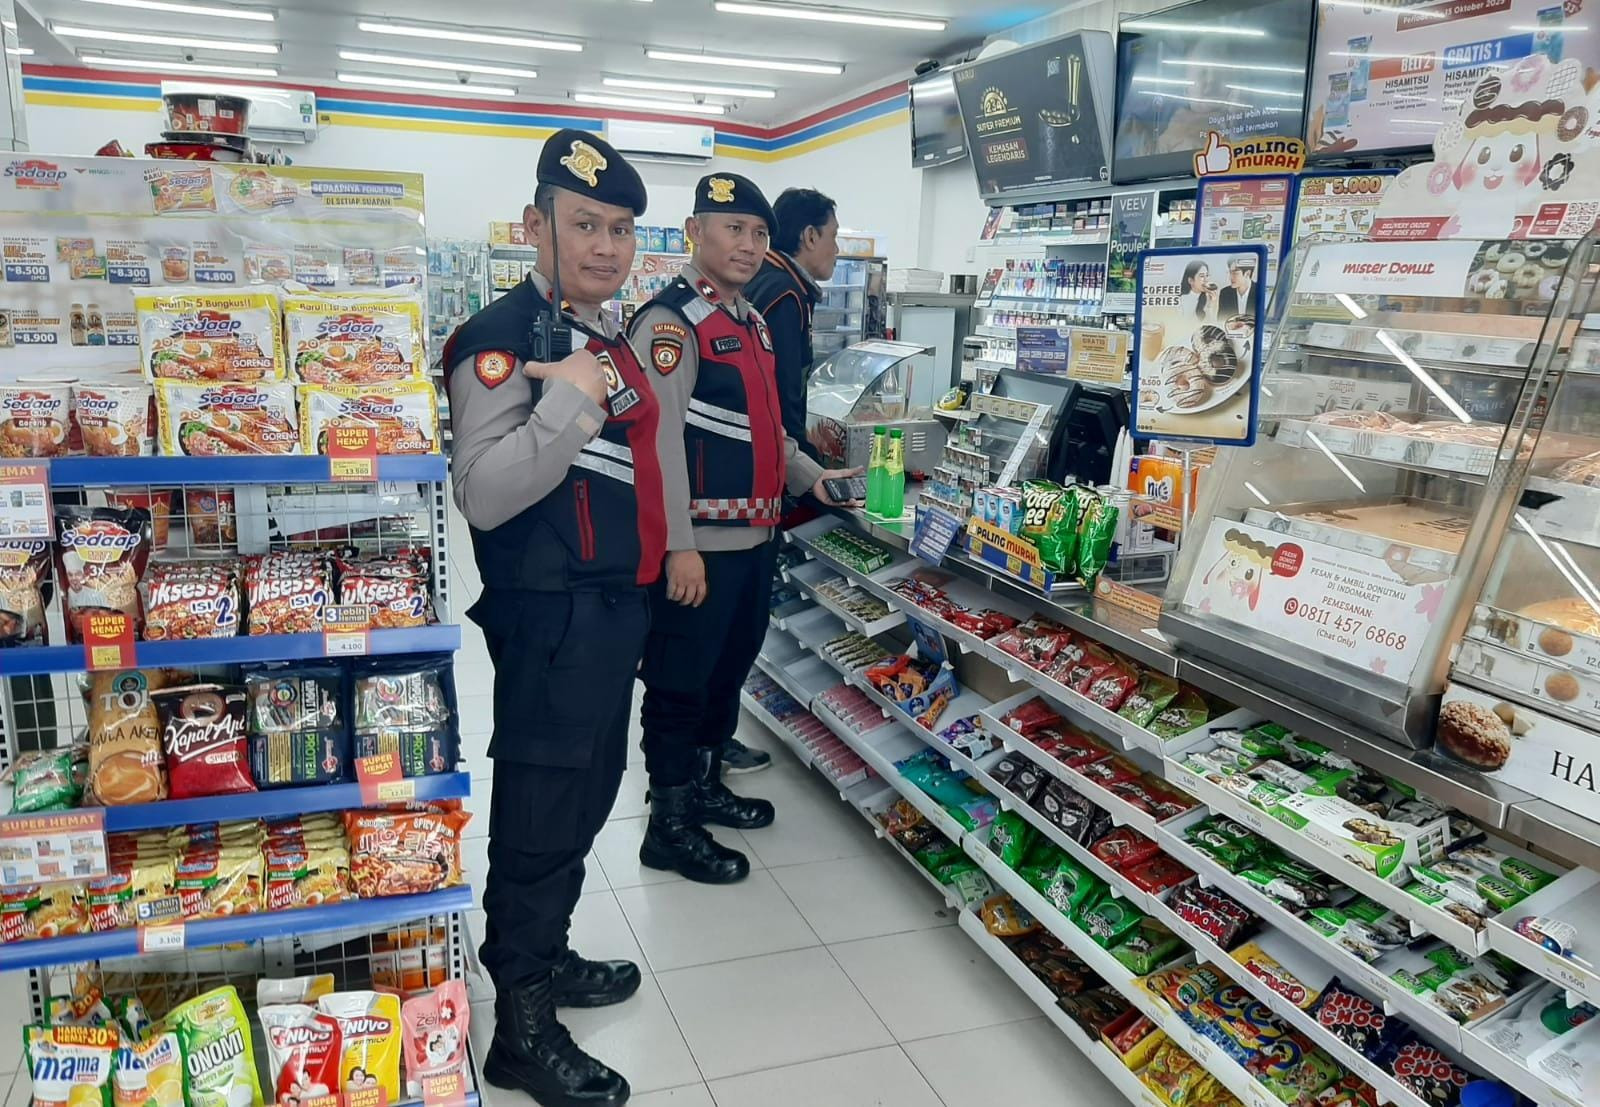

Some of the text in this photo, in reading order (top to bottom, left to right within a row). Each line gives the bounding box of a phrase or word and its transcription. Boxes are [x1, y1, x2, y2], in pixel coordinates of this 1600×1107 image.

[1454, 3, 1484, 15] Oktober
[1447, 43, 1492, 66] GRATIS
[1401, 56, 1422, 73] BELI
[1445, 66, 1499, 82] HISAMIT
[1385, 75, 1430, 88] HISAMITSU
[985, 100, 1003, 113] 234
[1245, 110, 1260, 118] lebih
[976, 115, 1021, 132] SUPER PREMIUM
[1246, 121, 1278, 131] termakan
[988, 141, 1018, 154] KEMASAN
[1234, 141, 1298, 158] PALING
[986, 151, 1025, 164] LEGENDARIS
[1237, 155, 1300, 169] MURAH
[4, 166, 67, 182] Sedaap
[1331, 176, 1382, 195] 5.000
[1119, 198, 1148, 211] VEEV
[15, 266, 46, 275] 8.500
[117, 268, 147, 277] 8.300
[1342, 262, 1435, 274] mister Donut
[1143, 285, 1181, 296] COFFEE
[1142, 296, 1180, 306] SERIES
[170, 318, 242, 335] Sedaap
[316, 321, 383, 335] Sedaap
[23, 333, 55, 343] 8.900
[116, 335, 139, 344] 3.50
[232, 358, 271, 368] GORENG
[375, 363, 411, 372] GORENG
[3, 399, 61, 411] Sedaap
[77, 399, 118, 411] edaap
[199, 392, 268, 405] Sedaap
[338, 401, 404, 415] Sedaap
[262, 432, 299, 441] GORENG
[336, 429, 369, 438] SUPER
[336, 437, 369, 446] HEMAT
[396, 440, 431, 449] GORENG
[61, 531, 140, 550] Sedaap
[976, 526, 1006, 549] PALING
[1006, 536, 1037, 564] MURAH
[1311, 567, 1332, 579] PESAN
[1341, 577, 1364, 589] AMBIL
[1366, 583, 1407, 601] DONUTMU
[1327, 582, 1381, 603] DI INDOMARET
[289, 595, 311, 609] ISI
[391, 595, 425, 618] ISI 2
[1321, 596, 1375, 618] PEMESANAN:
[190, 595, 236, 627] ISI 2
[326, 607, 365, 622] 3 Lebih
[90, 616, 125, 627] SUPER
[1299, 603, 1407, 651] 0811 457 6868
[91, 626, 126, 635] HEMAT
[1316, 627, 1357, 649] (Chat Only)
[164, 713, 245, 757] Kapal Api
[362, 753, 393, 767] SUPER
[364, 761, 394, 774] HEMAT
[1550, 750, 1600, 796] HA
[2, 814, 96, 832] SUPER HEMAT
[139, 897, 179, 918] 5 Lebih
[160, 936, 181, 945] 3.100
[34, 1055, 99, 1081] mama
[431, 1074, 458, 1086] SUPER
[351, 1090, 379, 1100] SUPER
[430, 1083, 459, 1095] HEMAT
[308, 1096, 337, 1107] SUPER
[351, 1097, 380, 1107] HEMAT
